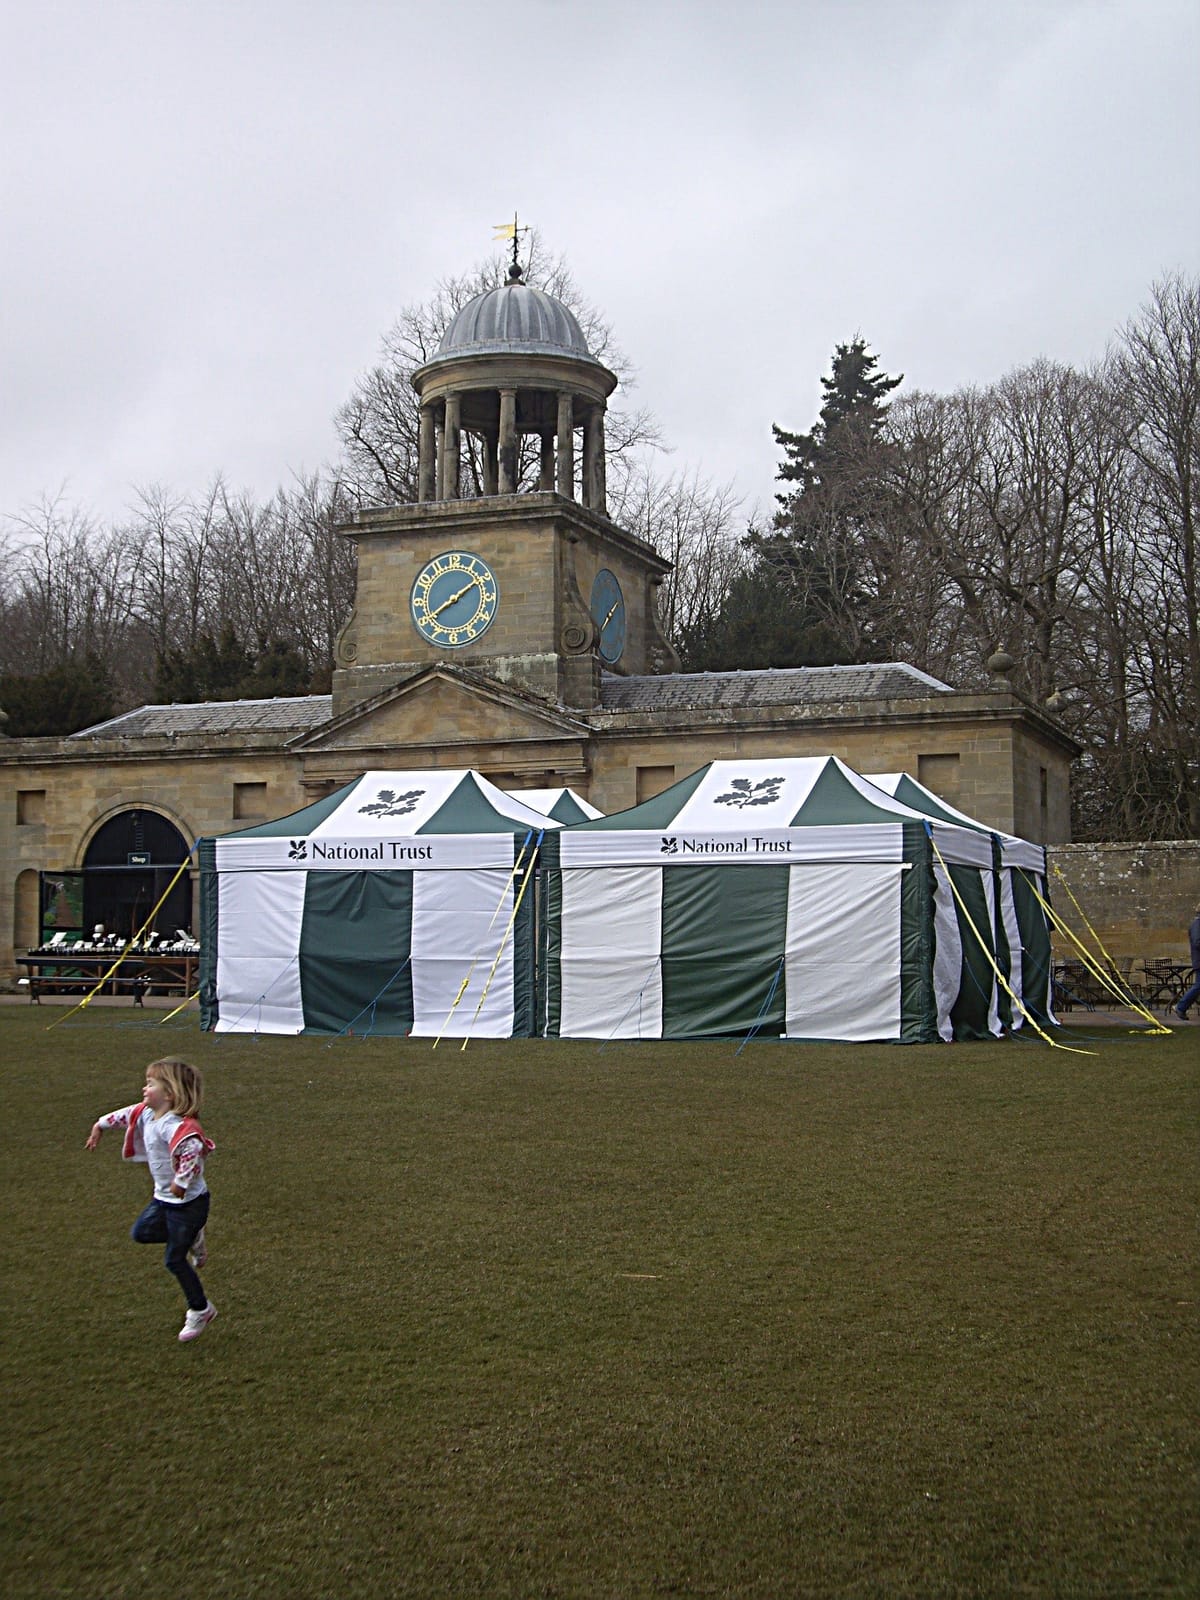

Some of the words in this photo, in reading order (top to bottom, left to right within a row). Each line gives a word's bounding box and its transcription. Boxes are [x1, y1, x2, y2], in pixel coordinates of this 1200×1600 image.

[432, 560, 443, 573] 11
[449, 555, 460, 568] 12
[417, 574, 432, 588] 10
[312, 842, 384, 860] National
[387, 842, 433, 860] Trust
[682, 837, 748, 853] National
[751, 837, 793, 852] Trust
